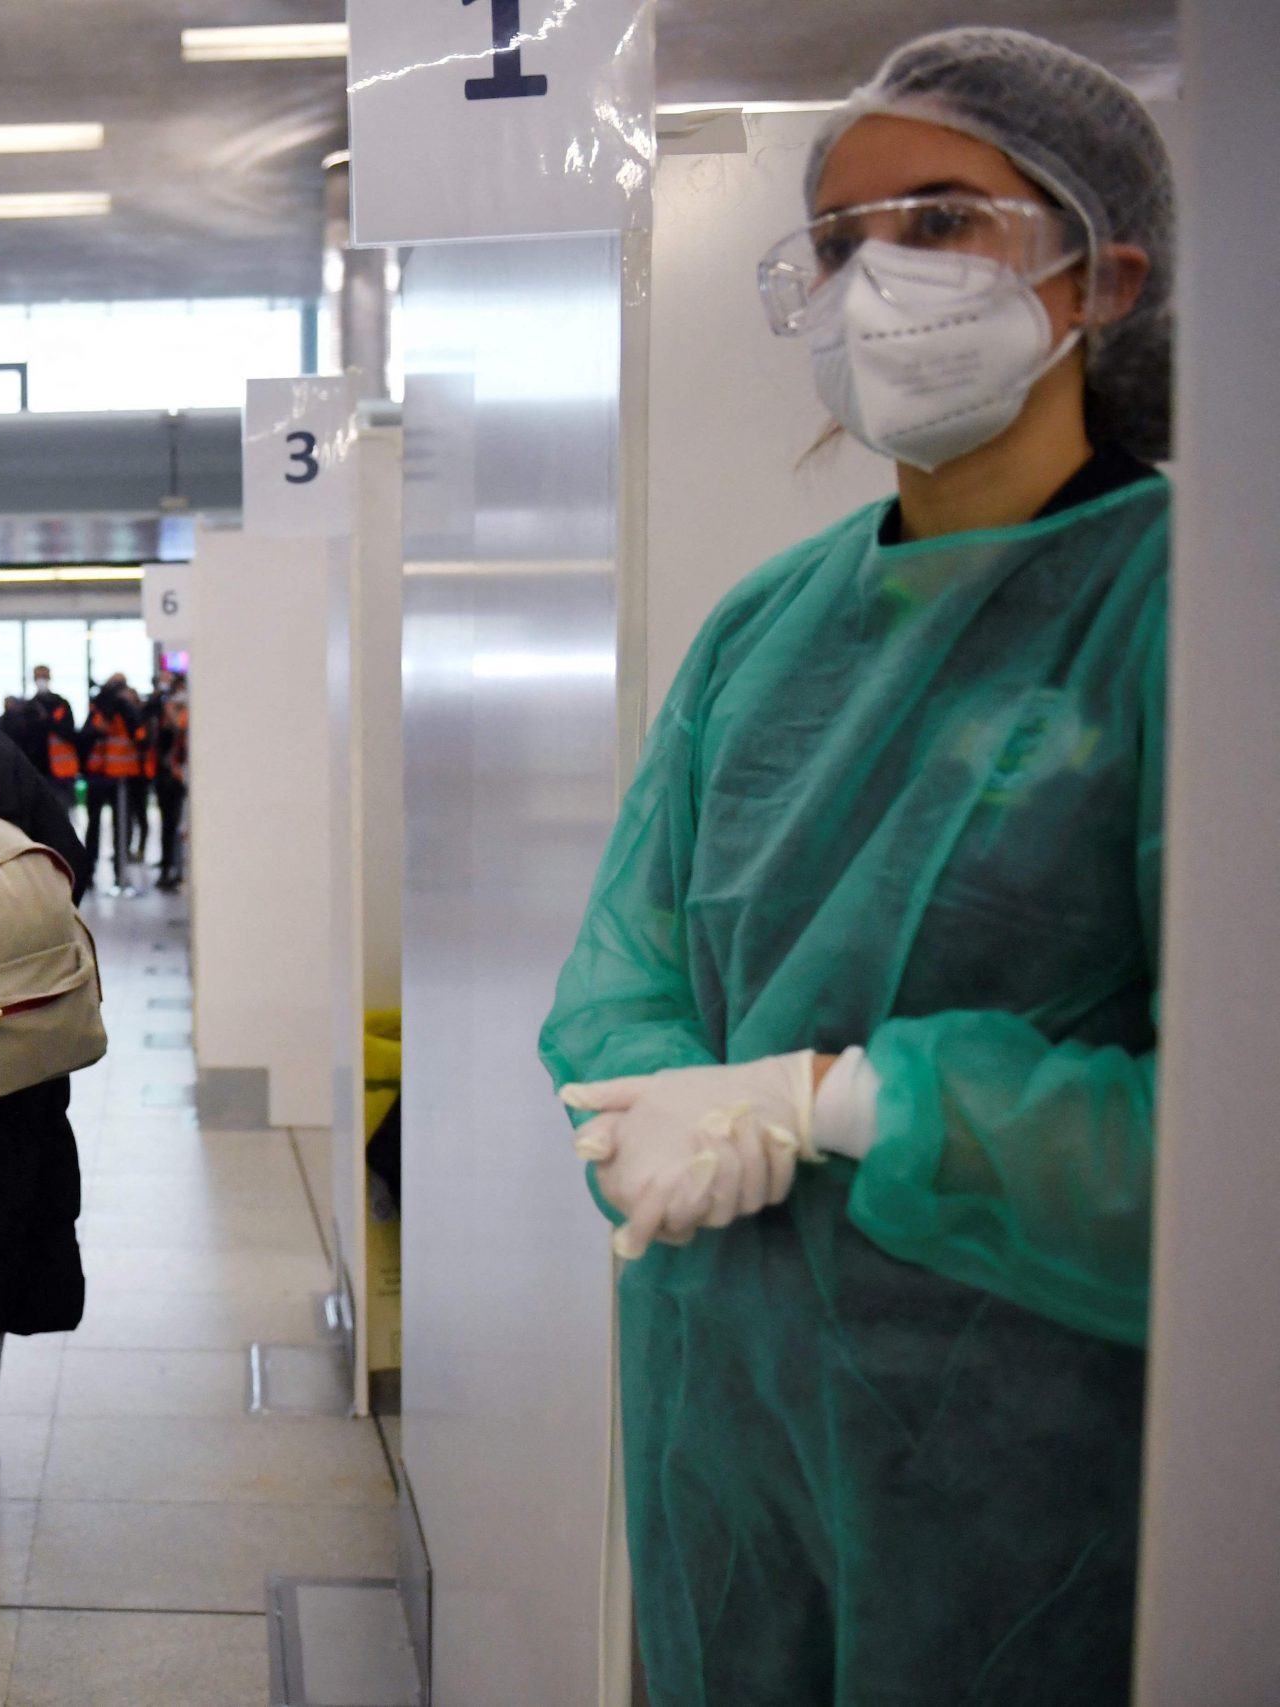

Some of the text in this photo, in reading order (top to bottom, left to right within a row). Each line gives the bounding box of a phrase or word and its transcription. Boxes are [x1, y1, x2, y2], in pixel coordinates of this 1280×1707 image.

[462, 0, 548, 100] 1
[284, 431, 319, 484] 3
[162, 590, 179, 616] 6
